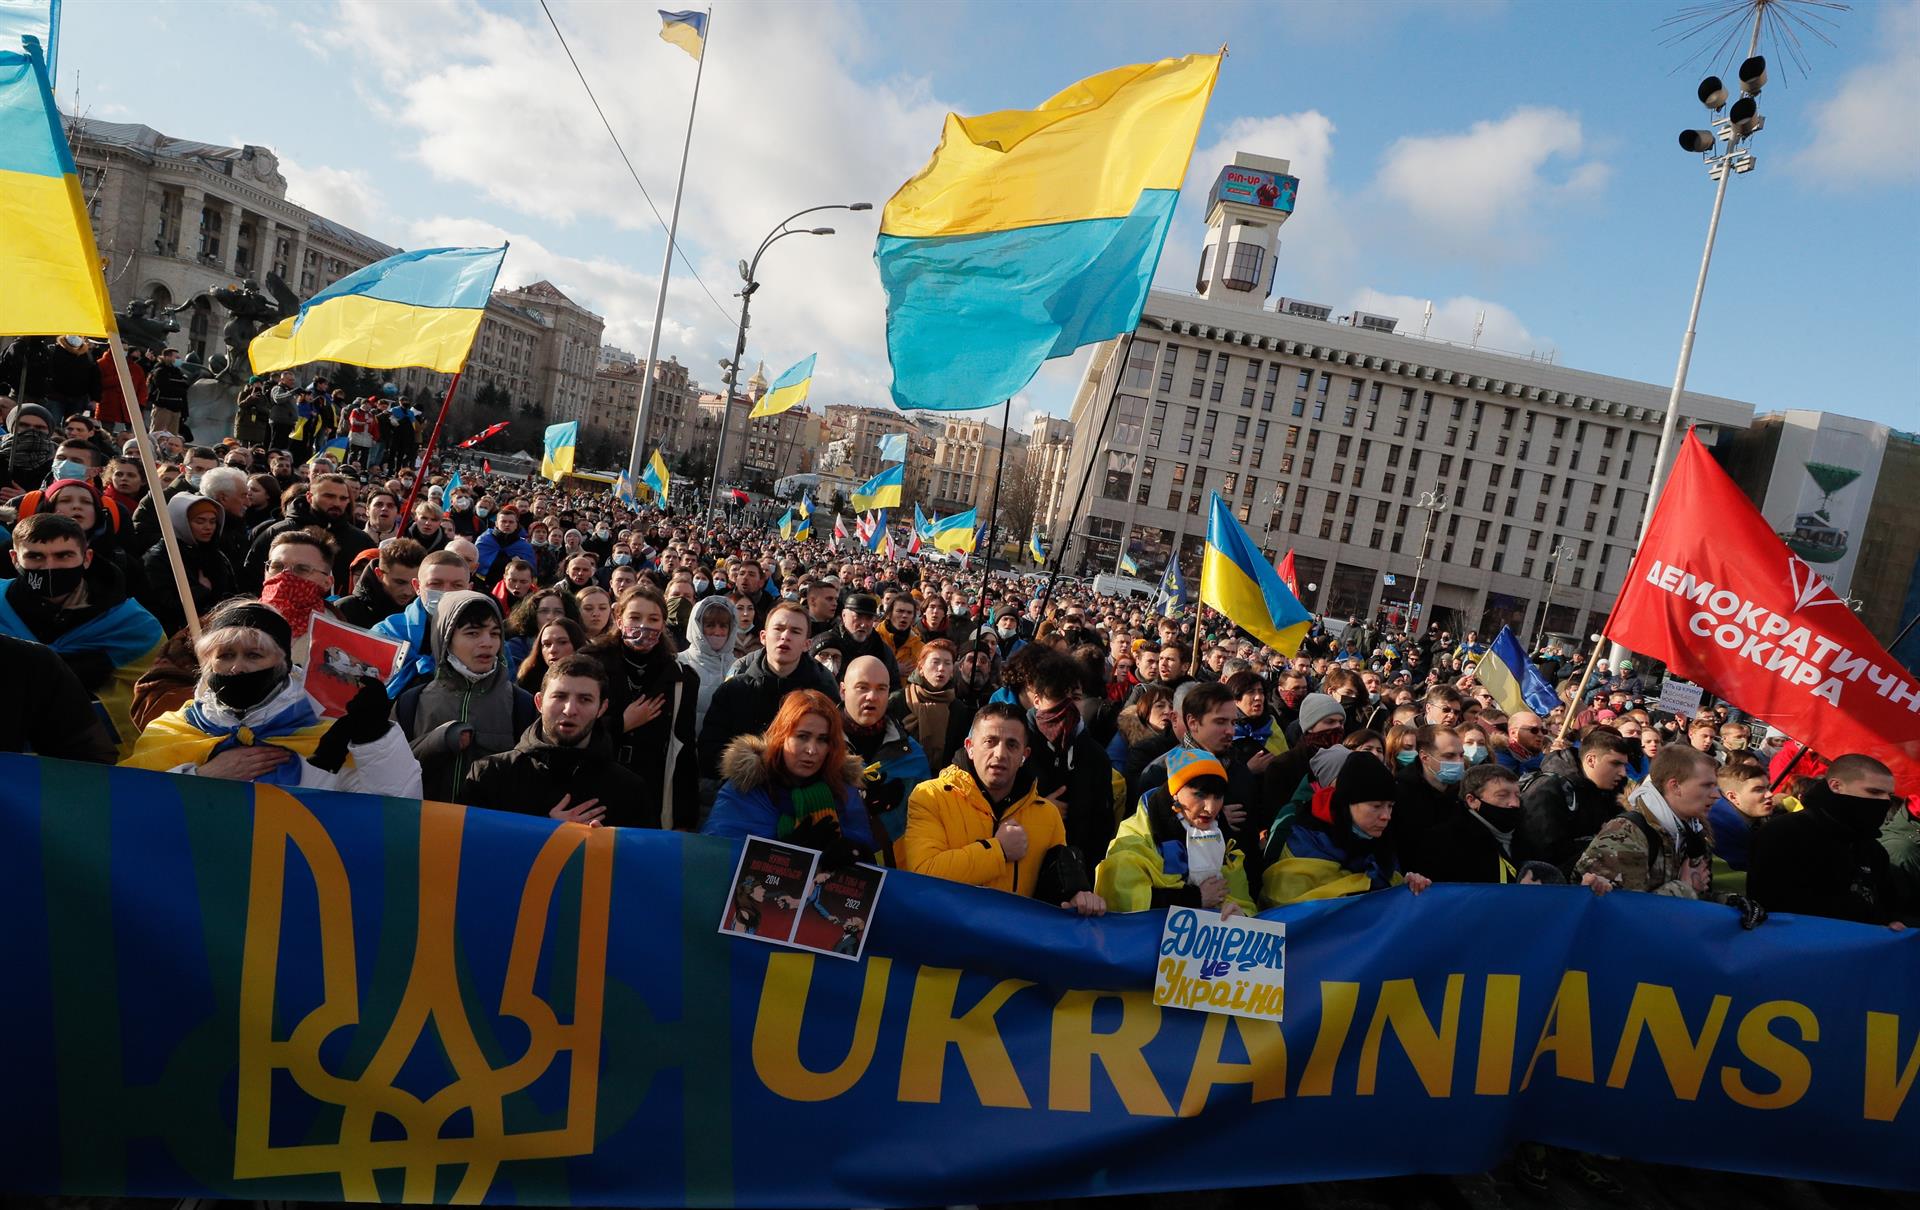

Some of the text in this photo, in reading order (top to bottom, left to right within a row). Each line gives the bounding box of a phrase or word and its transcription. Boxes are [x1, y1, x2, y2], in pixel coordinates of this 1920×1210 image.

[1689, 612, 1843, 707] СОКИРА
[765, 874, 781, 886] 2014
[845, 898, 861, 910] 2022
[1160, 909, 1286, 972] Донецьк
[1154, 957, 1284, 1016] Україна
[752, 952, 1820, 1118] UKRAINIANS
